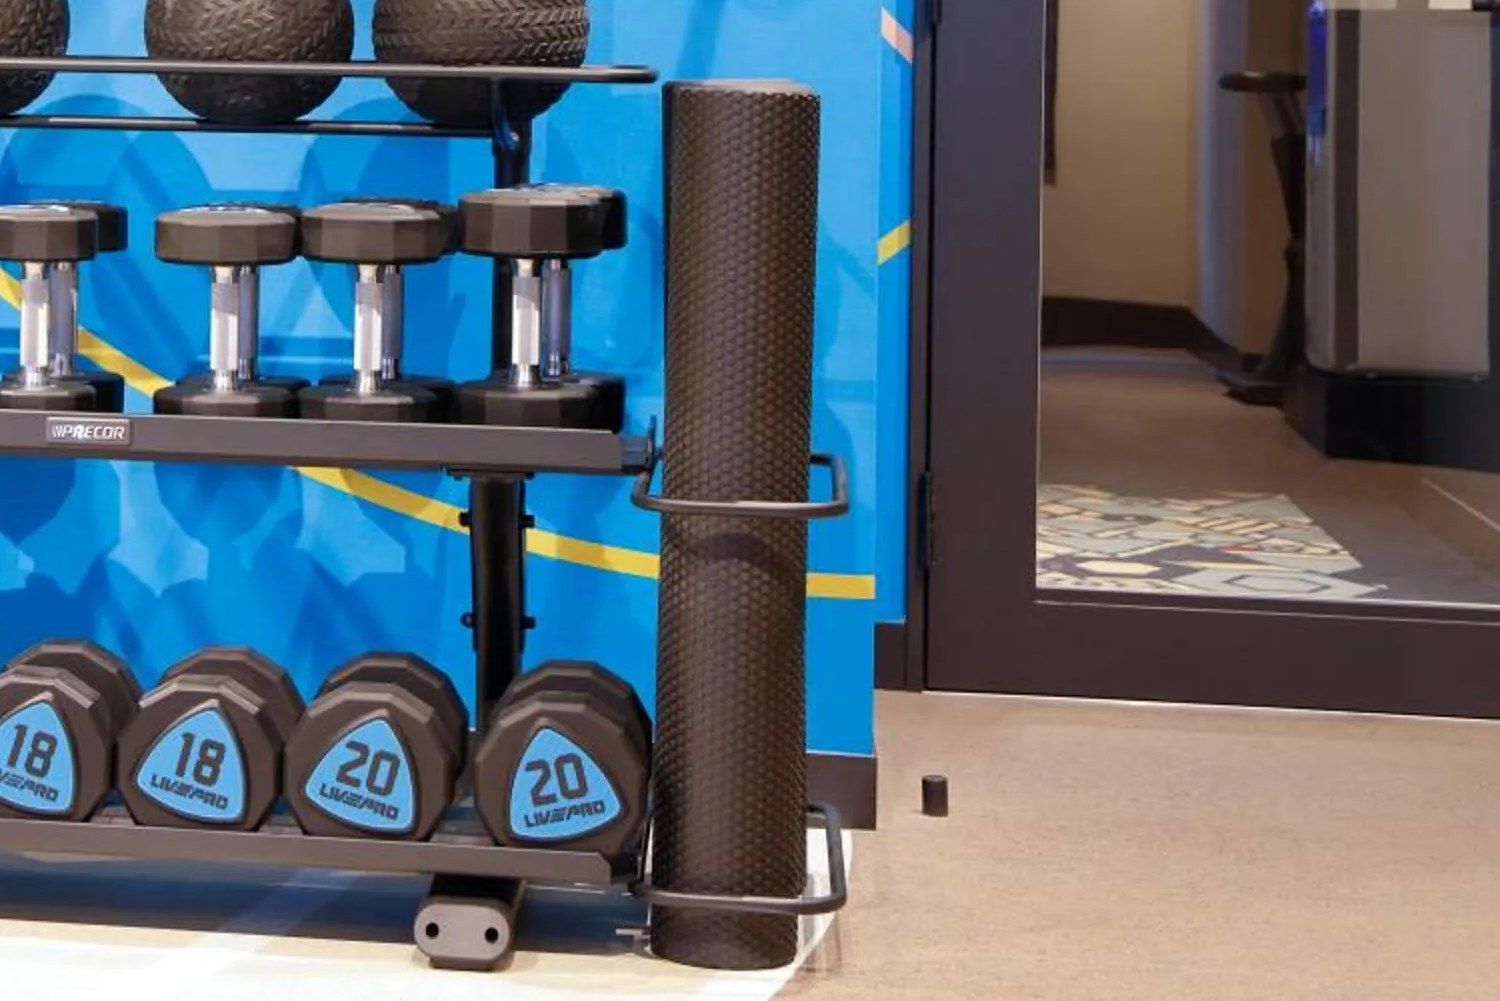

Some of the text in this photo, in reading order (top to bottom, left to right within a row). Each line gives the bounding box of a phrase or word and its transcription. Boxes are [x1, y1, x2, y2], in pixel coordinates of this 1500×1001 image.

[60, 424, 125, 440] PRECOR
[7, 723, 58, 777] 18
[175, 732, 226, 786] 18
[336, 740, 400, 796] 20
[151, 774, 228, 810] LIVEPRO
[319, 783, 398, 820] LIVEPRO
[525, 753, 588, 806] 20
[524, 800, 605, 827] LIVEPRO
